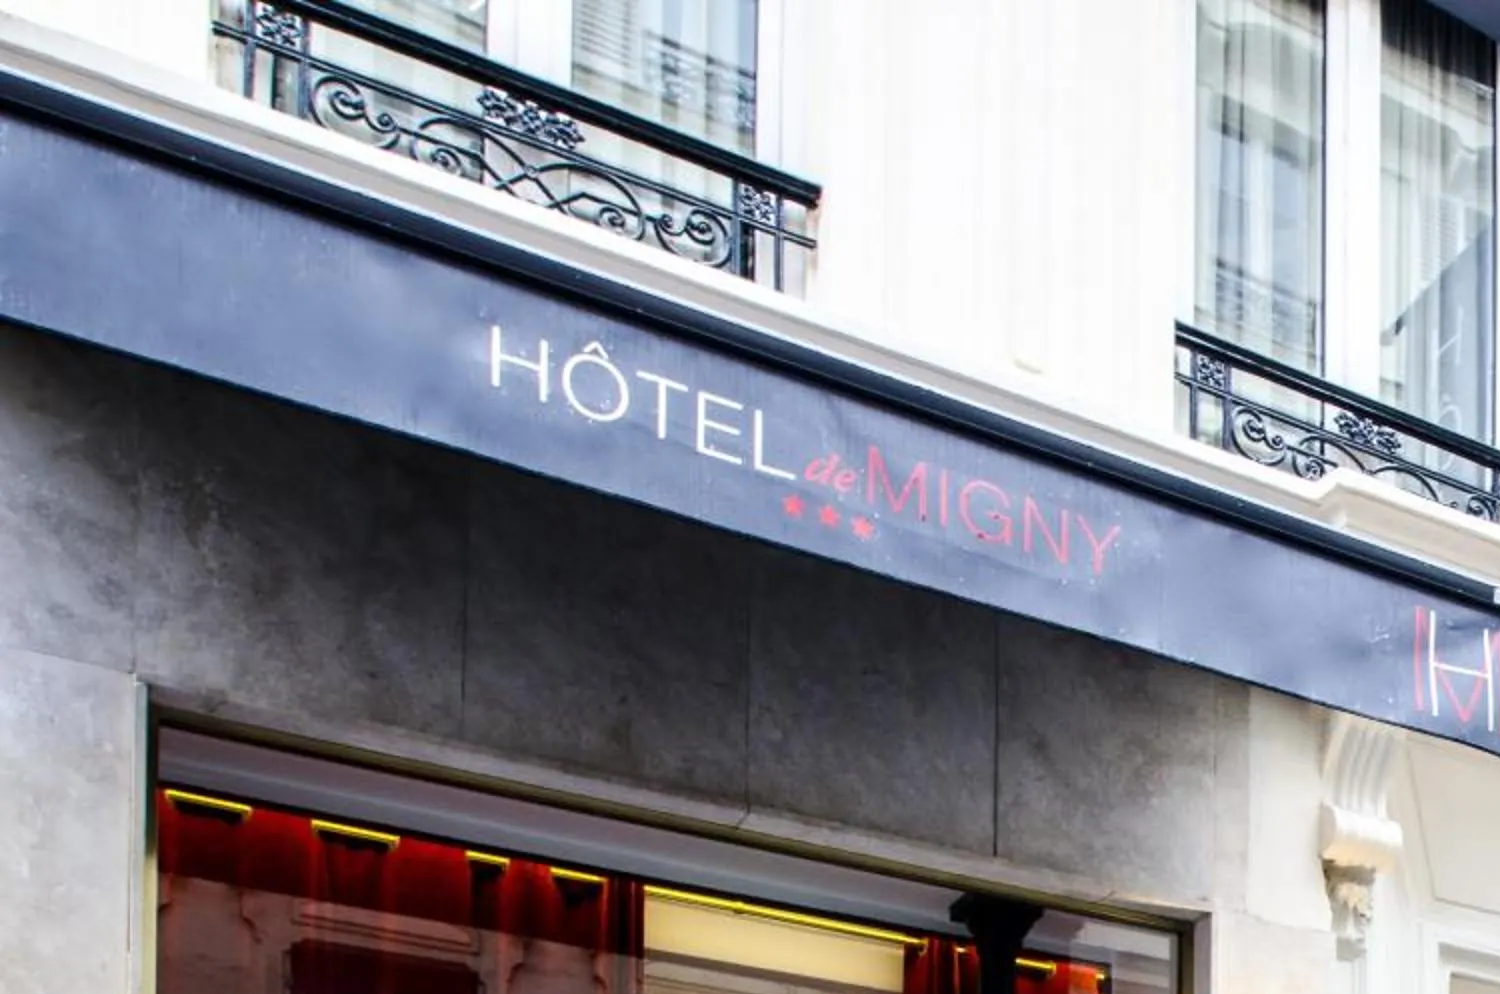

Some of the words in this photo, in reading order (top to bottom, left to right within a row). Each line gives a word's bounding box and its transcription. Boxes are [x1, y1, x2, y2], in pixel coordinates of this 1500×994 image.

[490, 325, 796, 481] HÔTEL
[804, 451, 857, 493] de
[866, 444, 1121, 577] MIGNY
